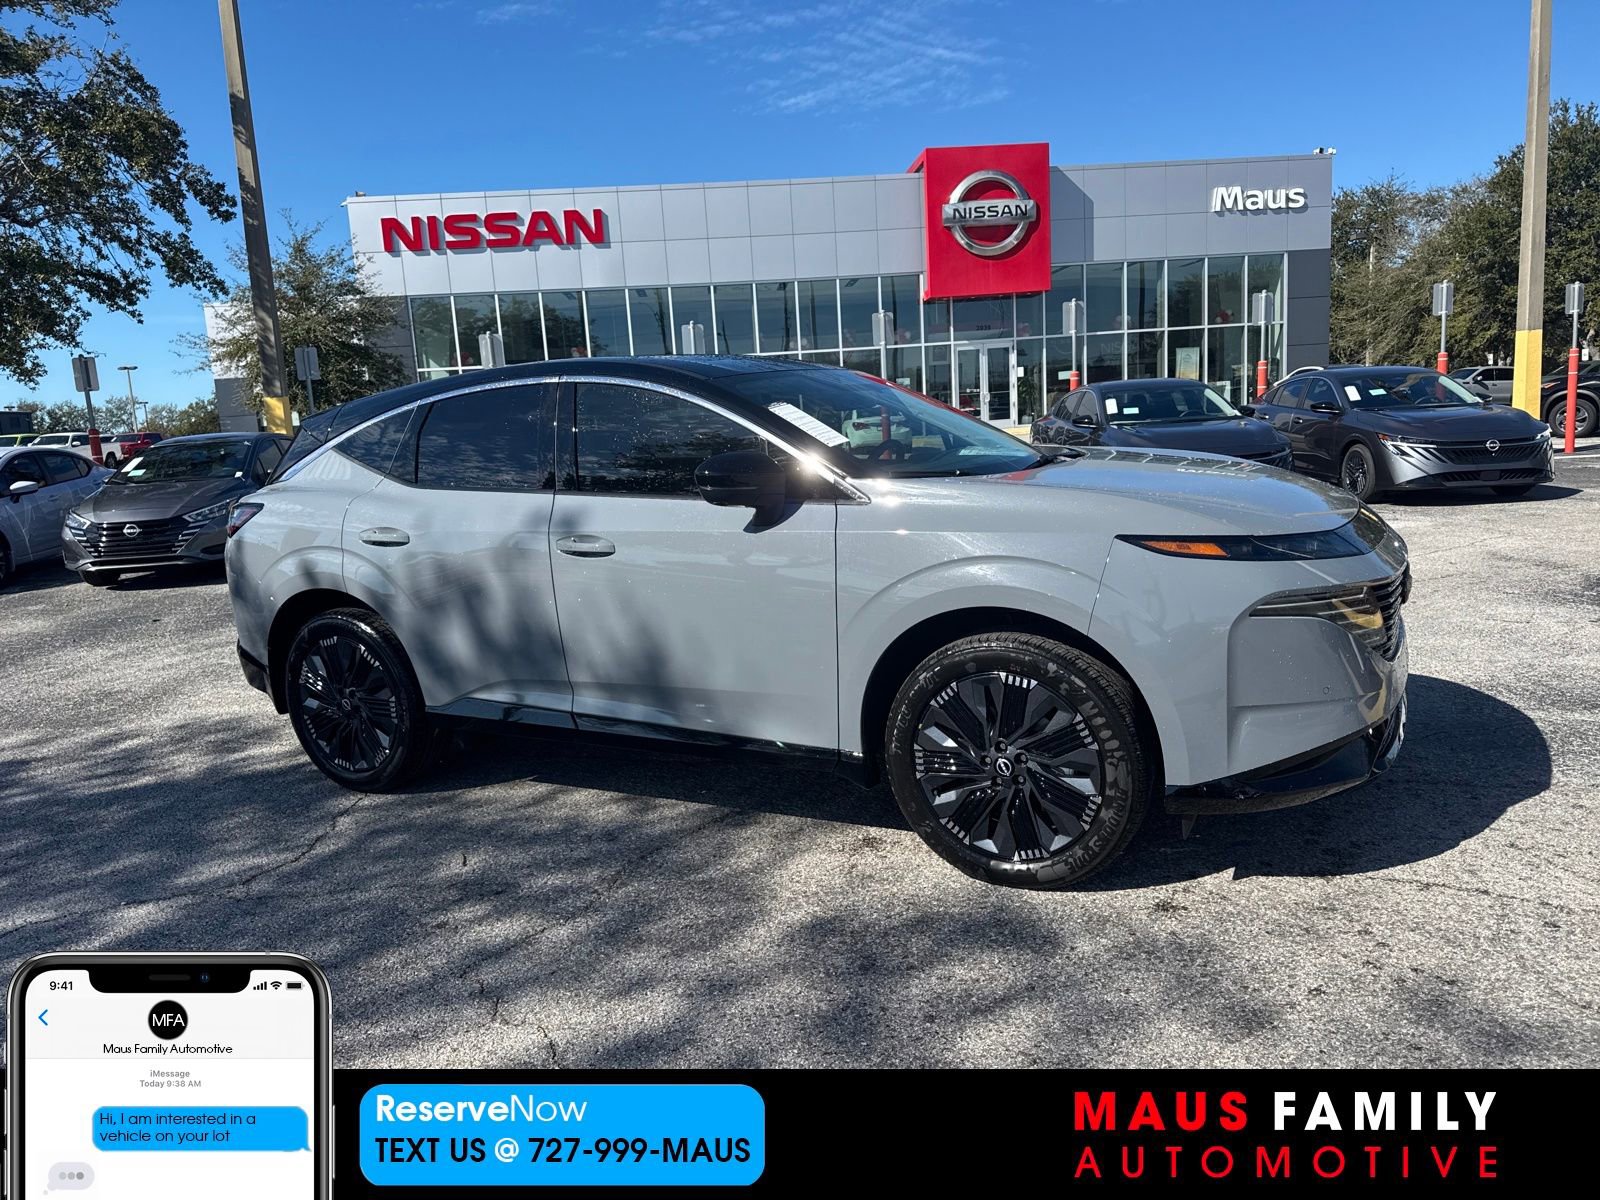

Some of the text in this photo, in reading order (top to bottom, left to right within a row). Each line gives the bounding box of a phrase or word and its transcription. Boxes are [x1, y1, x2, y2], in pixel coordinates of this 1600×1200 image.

[952, 204, 1028, 220] NISSAN
[1212, 186, 1305, 212] Maus
[381, 209, 605, 252] NISSAN
